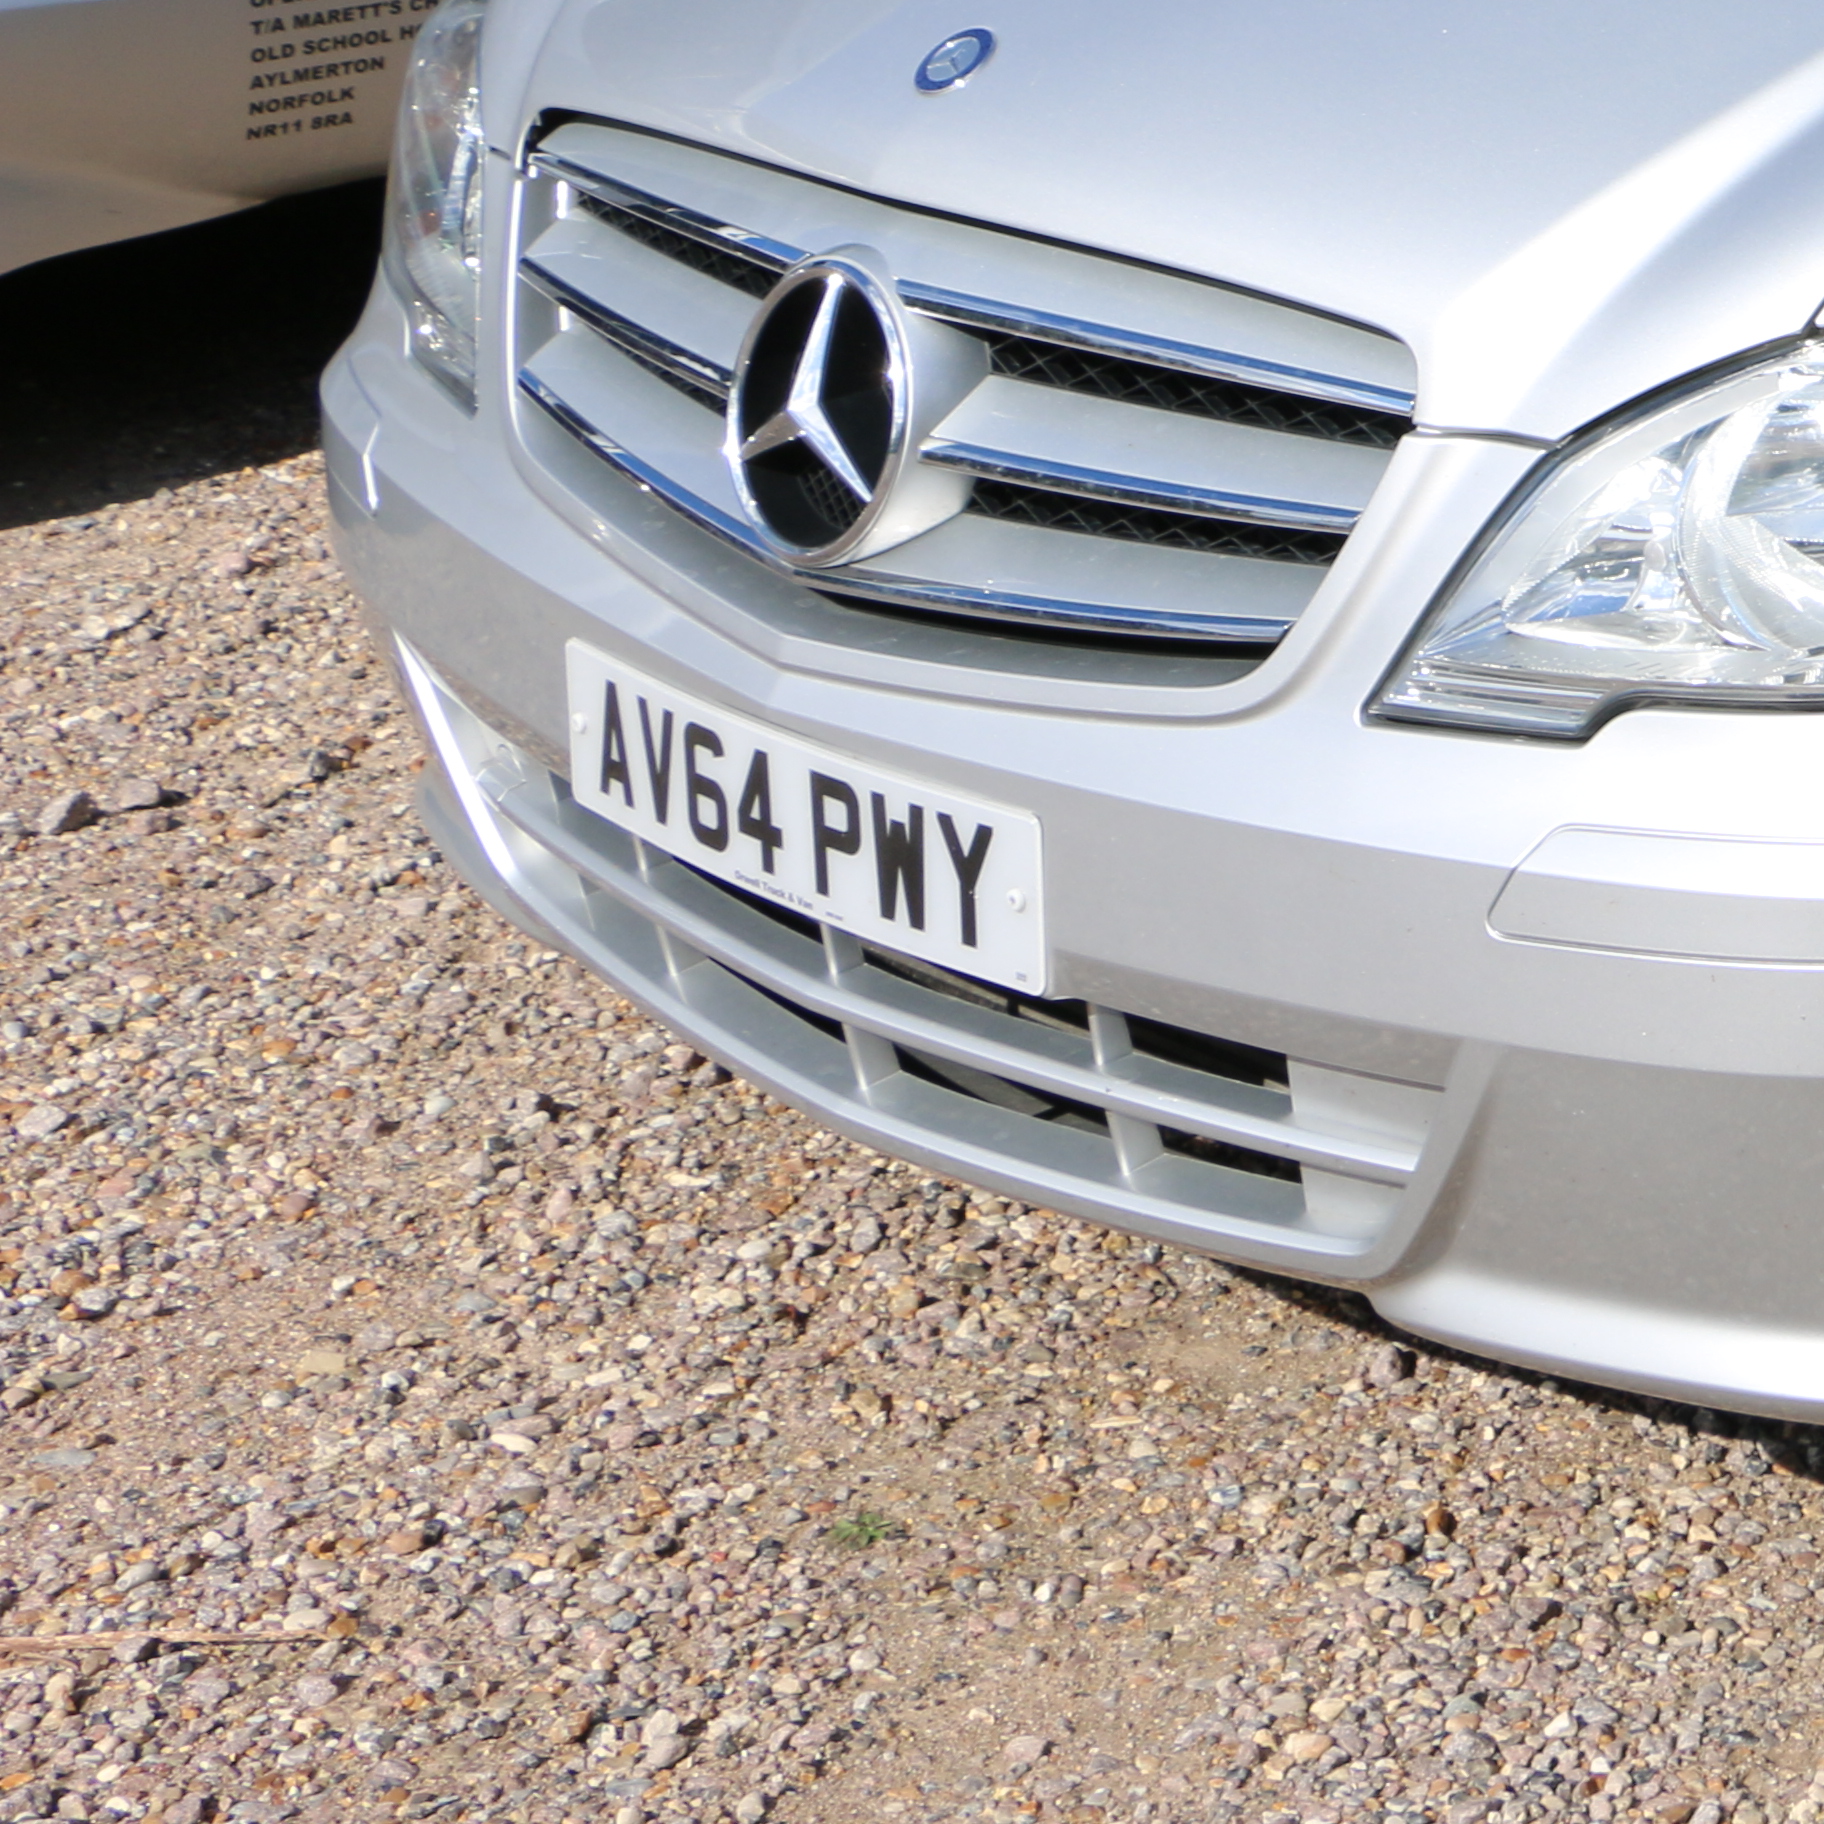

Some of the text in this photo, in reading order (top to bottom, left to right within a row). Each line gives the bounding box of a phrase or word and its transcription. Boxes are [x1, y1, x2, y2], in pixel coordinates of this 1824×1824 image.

[251, 17, 285, 34] T/A
[294, 0, 401, 29] MARETT'S
[251, 43, 294, 62] OLD
[302, 29, 392, 54] SCHOOL
[250, 56, 385, 90] AYLMERTON
[249, 86, 355, 115] NORFOLK
[247, 112, 353, 140] NR11 8RA
[599, 679, 994, 950] AV64 PWY
